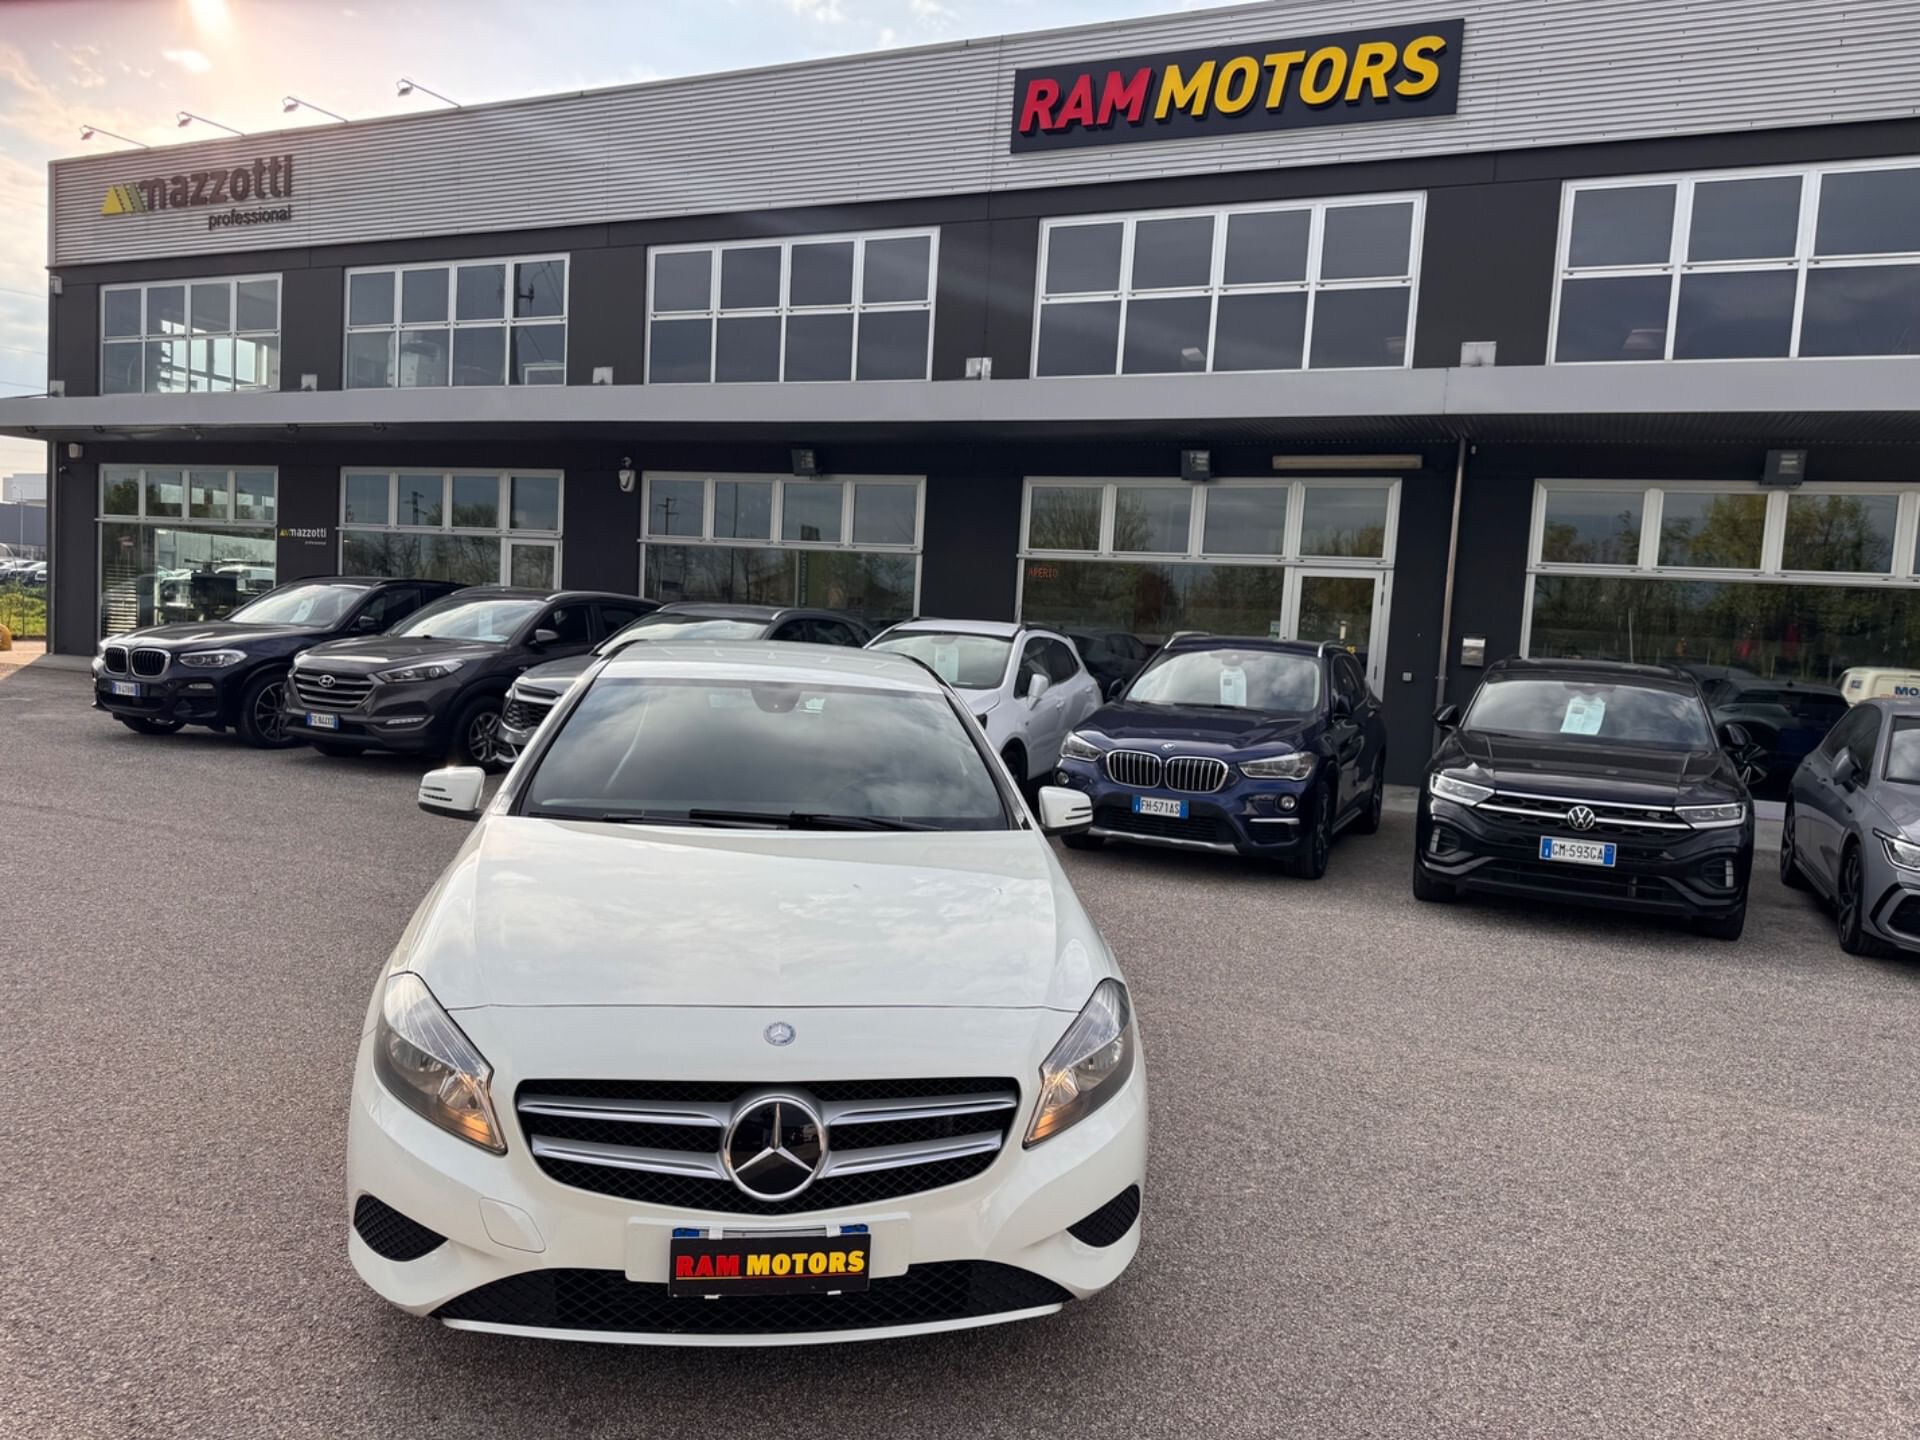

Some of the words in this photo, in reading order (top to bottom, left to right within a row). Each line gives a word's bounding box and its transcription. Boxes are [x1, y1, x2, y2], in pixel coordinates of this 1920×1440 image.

[1018, 66, 1152, 133] RAM
[1153, 34, 1447, 120] MOTORS
[138, 154, 293, 211] mazzotti
[207, 204, 293, 231] professional
[675, 1254, 741, 1277] RAM
[746, 1249, 865, 1276] MOTORS
